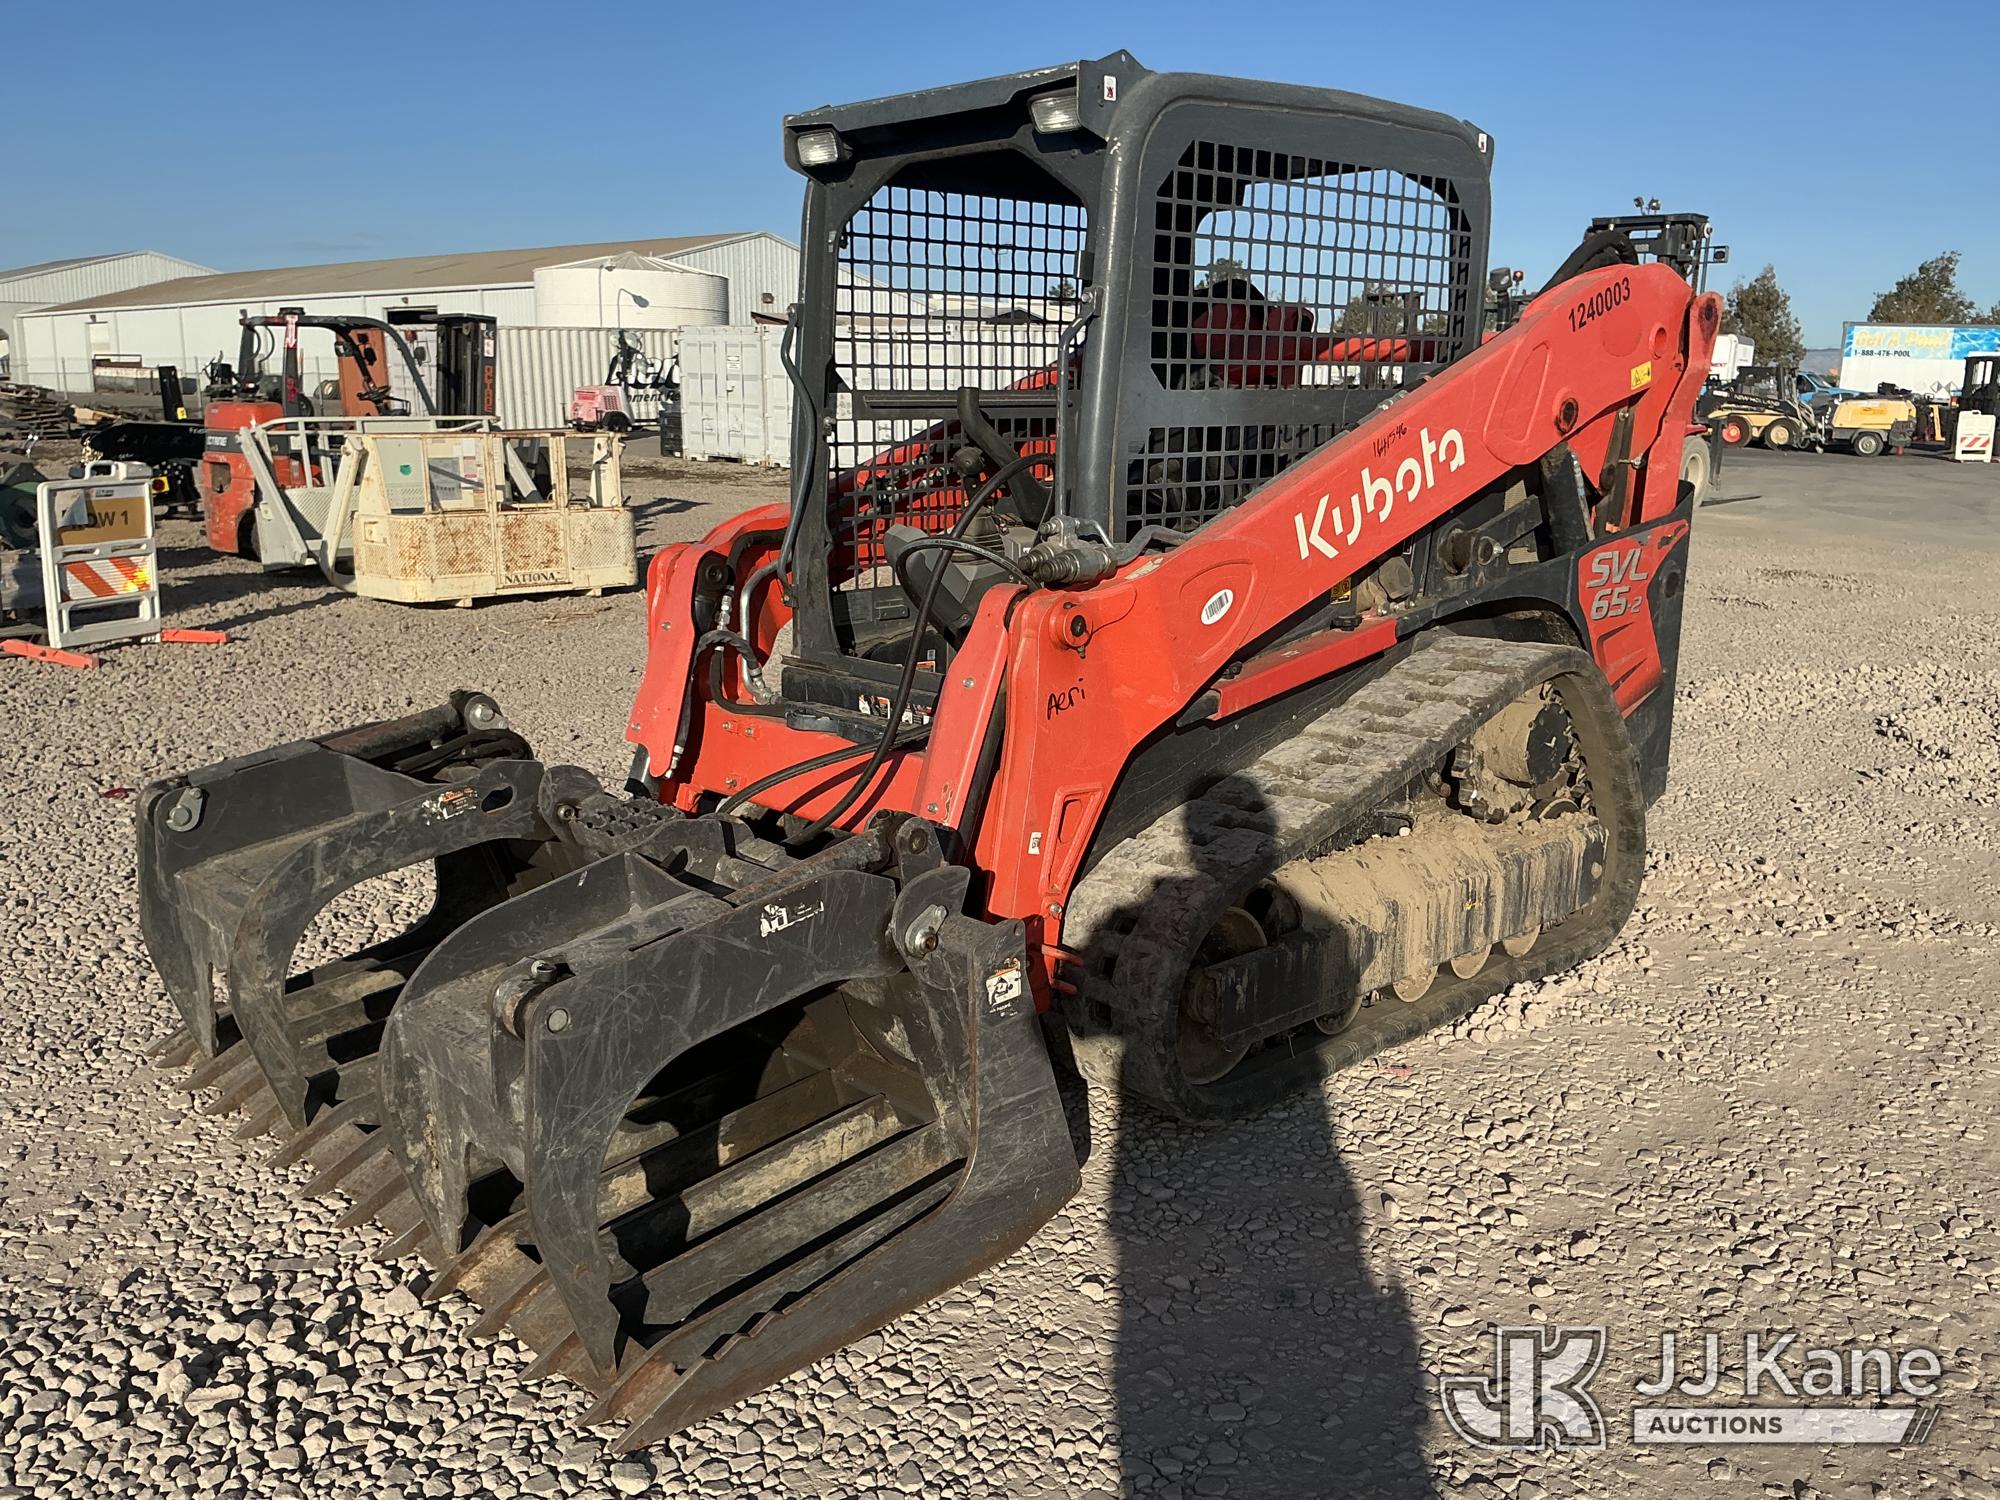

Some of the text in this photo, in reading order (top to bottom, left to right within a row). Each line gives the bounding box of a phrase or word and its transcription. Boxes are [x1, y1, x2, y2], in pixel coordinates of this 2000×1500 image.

[1568, 276, 1631, 333] 1240003
[121, 510, 129, 525] 1
[1294, 427, 1465, 560] Kubota
[1586, 547, 1648, 588] SVL
